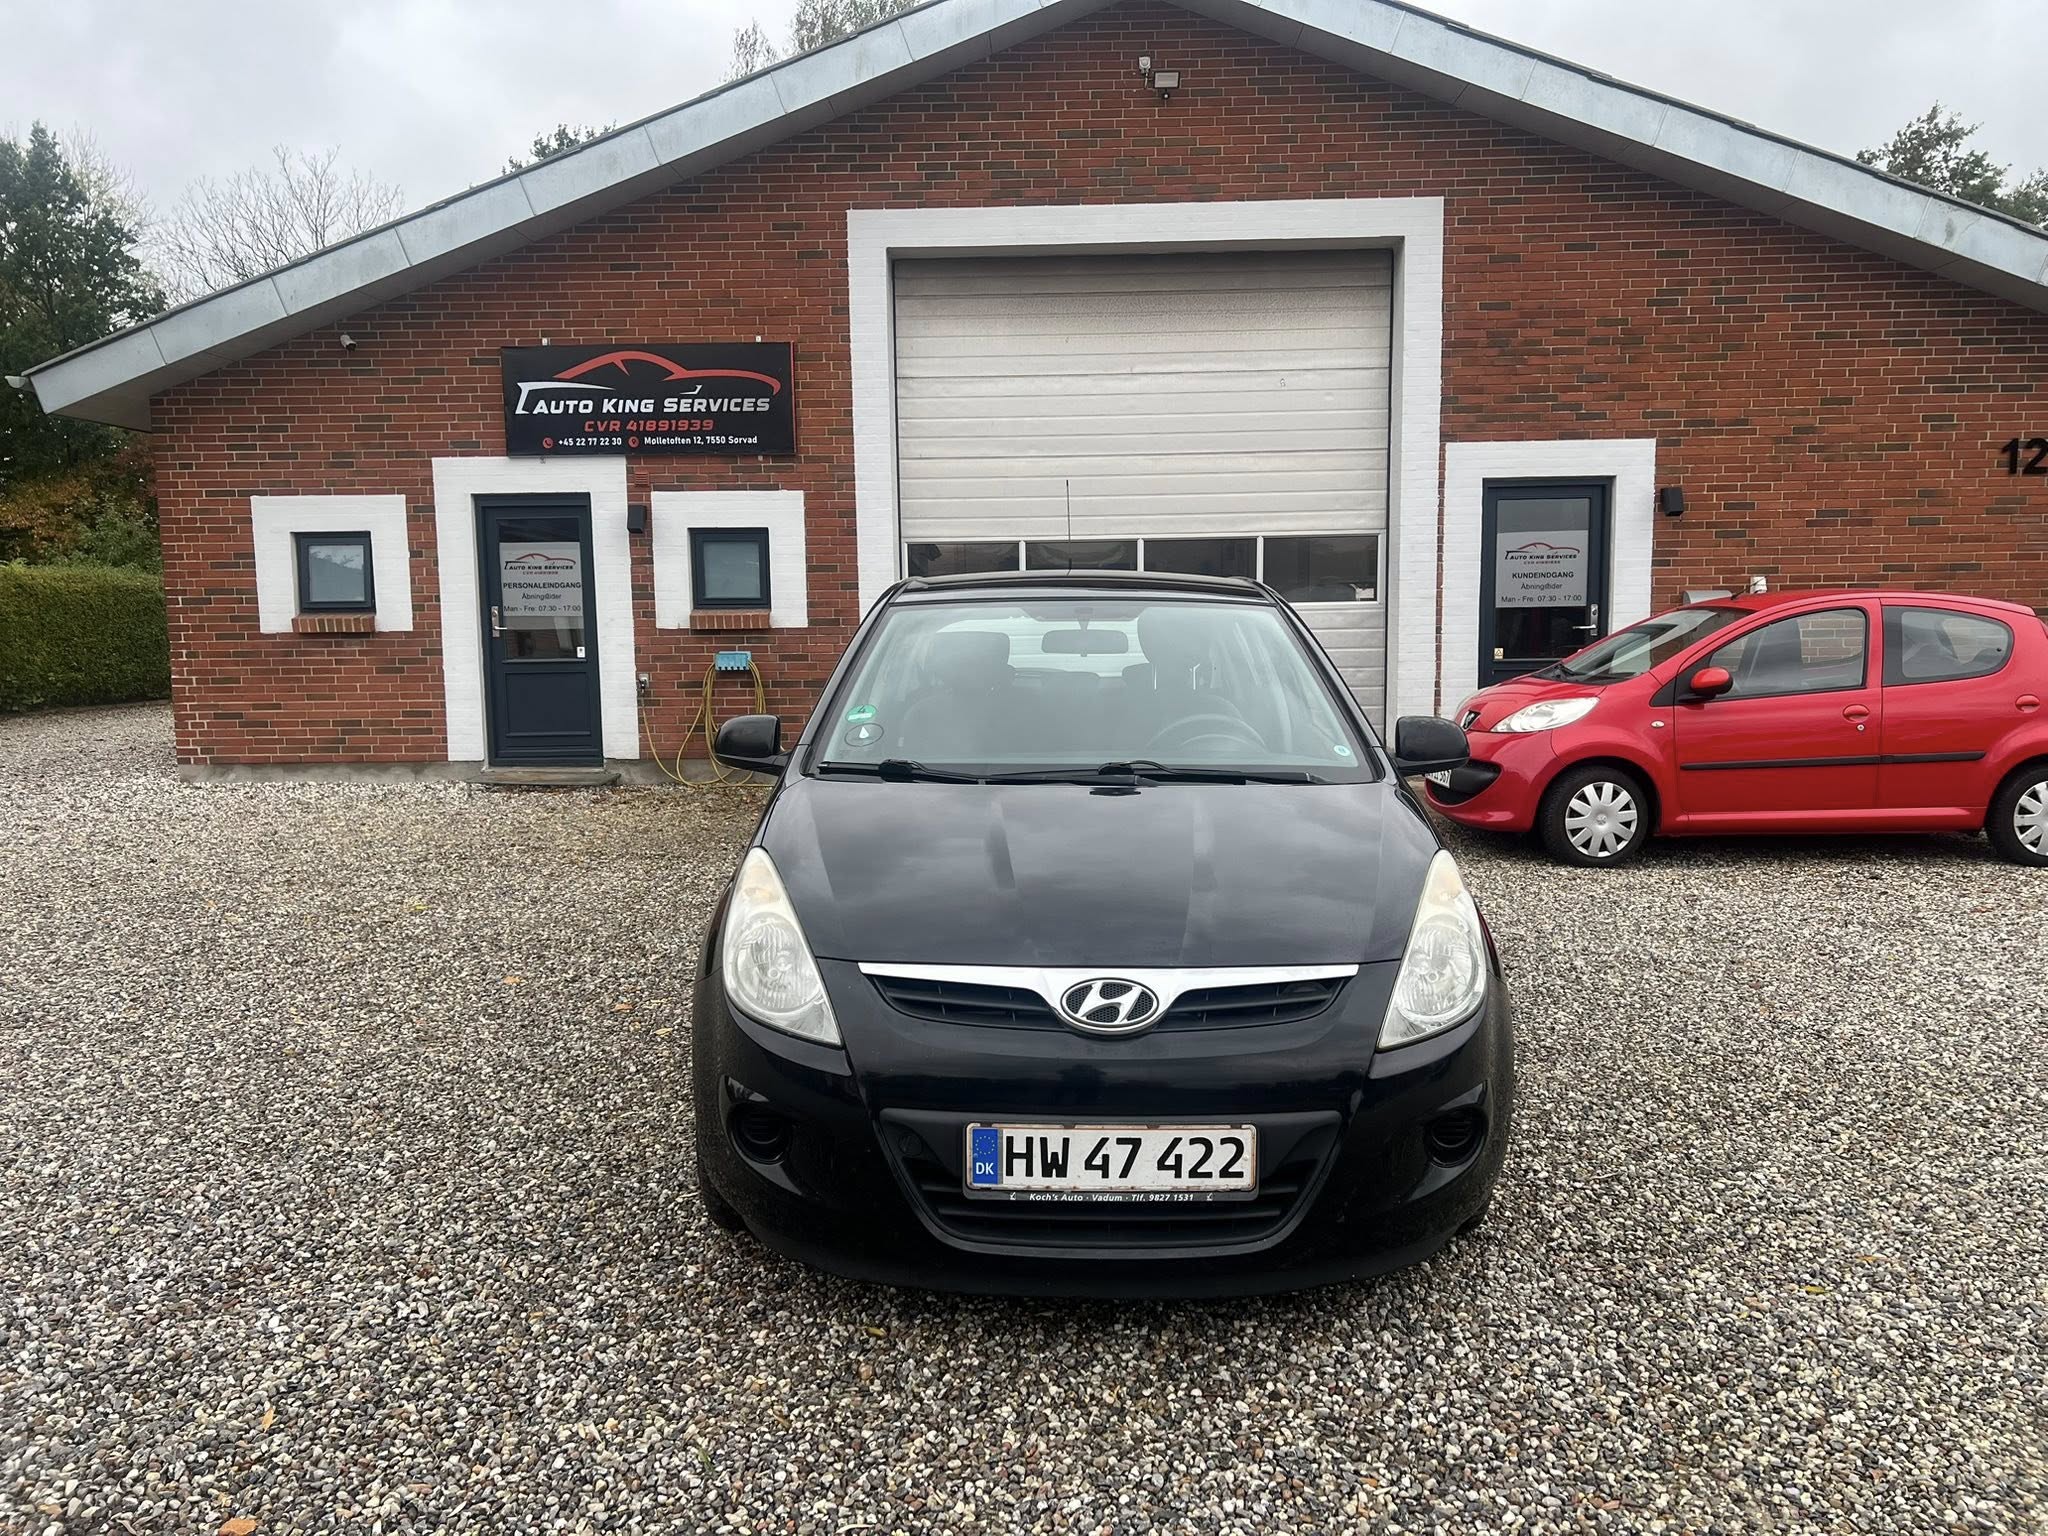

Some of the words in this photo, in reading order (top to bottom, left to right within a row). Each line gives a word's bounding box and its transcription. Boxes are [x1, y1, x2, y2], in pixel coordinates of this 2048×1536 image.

[532, 399, 594, 415] AUTO
[602, 398, 655, 414] KING
[663, 397, 770, 414] SERVICES
[584, 420, 621, 433] CVR
[626, 419, 715, 432] 41891939
[558, 437, 574, 446] +45
[575, 437, 586, 446] 22
[587, 437, 598, 446] 77
[599, 437, 610, 446] 22
[611, 437, 622, 446] 30
[693, 436, 704, 445] 12,
[705, 436, 726, 444] 7550
[2000, 437, 2048, 475] 12
[1512, 571, 1574, 579] KUNDEINDGANG
[975, 1162, 994, 1175] DK
[1005, 1136, 1070, 1178] HW
[1084, 1137, 1142, 1178] 47
[1156, 1137, 1244, 1178] 422
[1029, 1193, 1058, 1201] Koch's
[1060, 1193, 1083, 1201] Auto
[1091, 1193, 1123, 1202] Vadum
[1131, 1193, 1146, 1202] Tlf.
[1149, 1193, 1170, 1202] 9827
[1173, 1193, 1194, 1202] 1531
